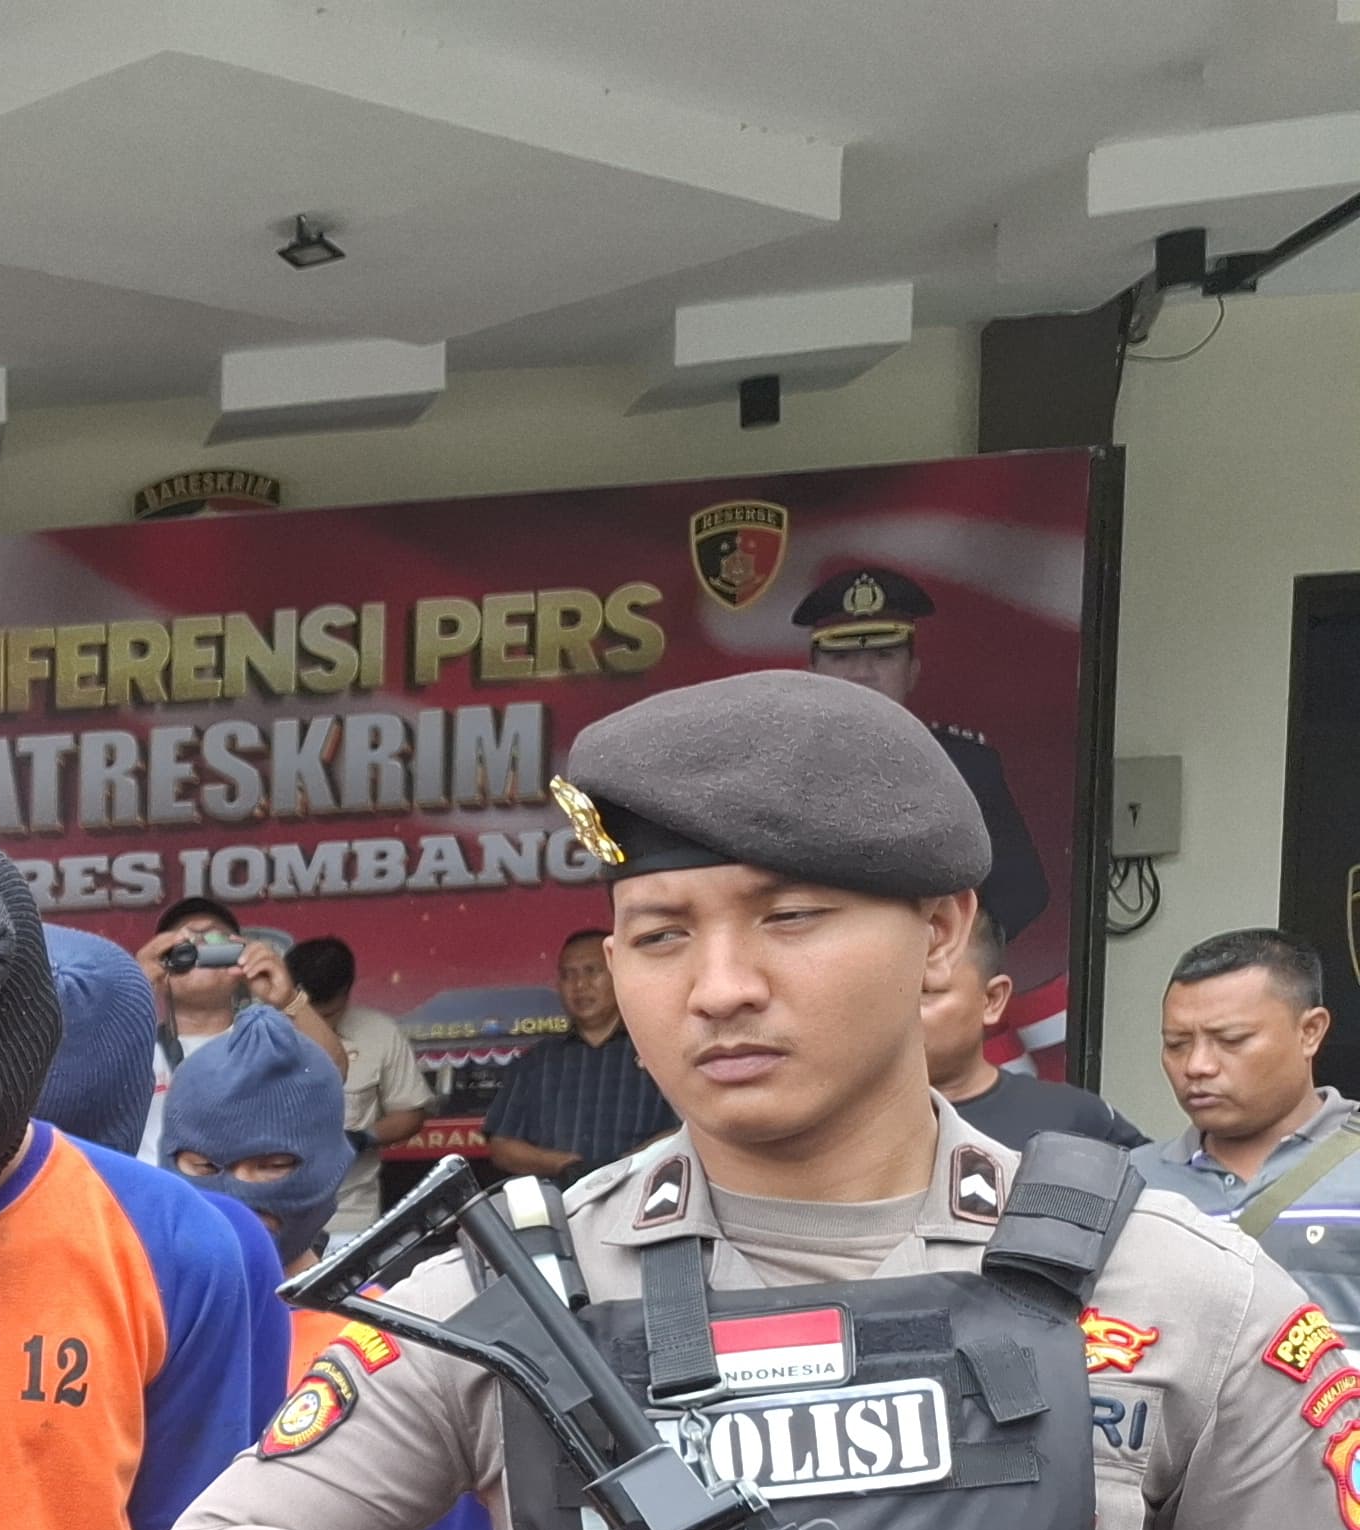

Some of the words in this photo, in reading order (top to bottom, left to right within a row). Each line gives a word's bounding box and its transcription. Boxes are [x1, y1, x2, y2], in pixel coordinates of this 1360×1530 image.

[415, 582, 665, 683] PERS
[21, 1334, 89, 1408] 12
[726, 1361, 836, 1383] NDONESIA
